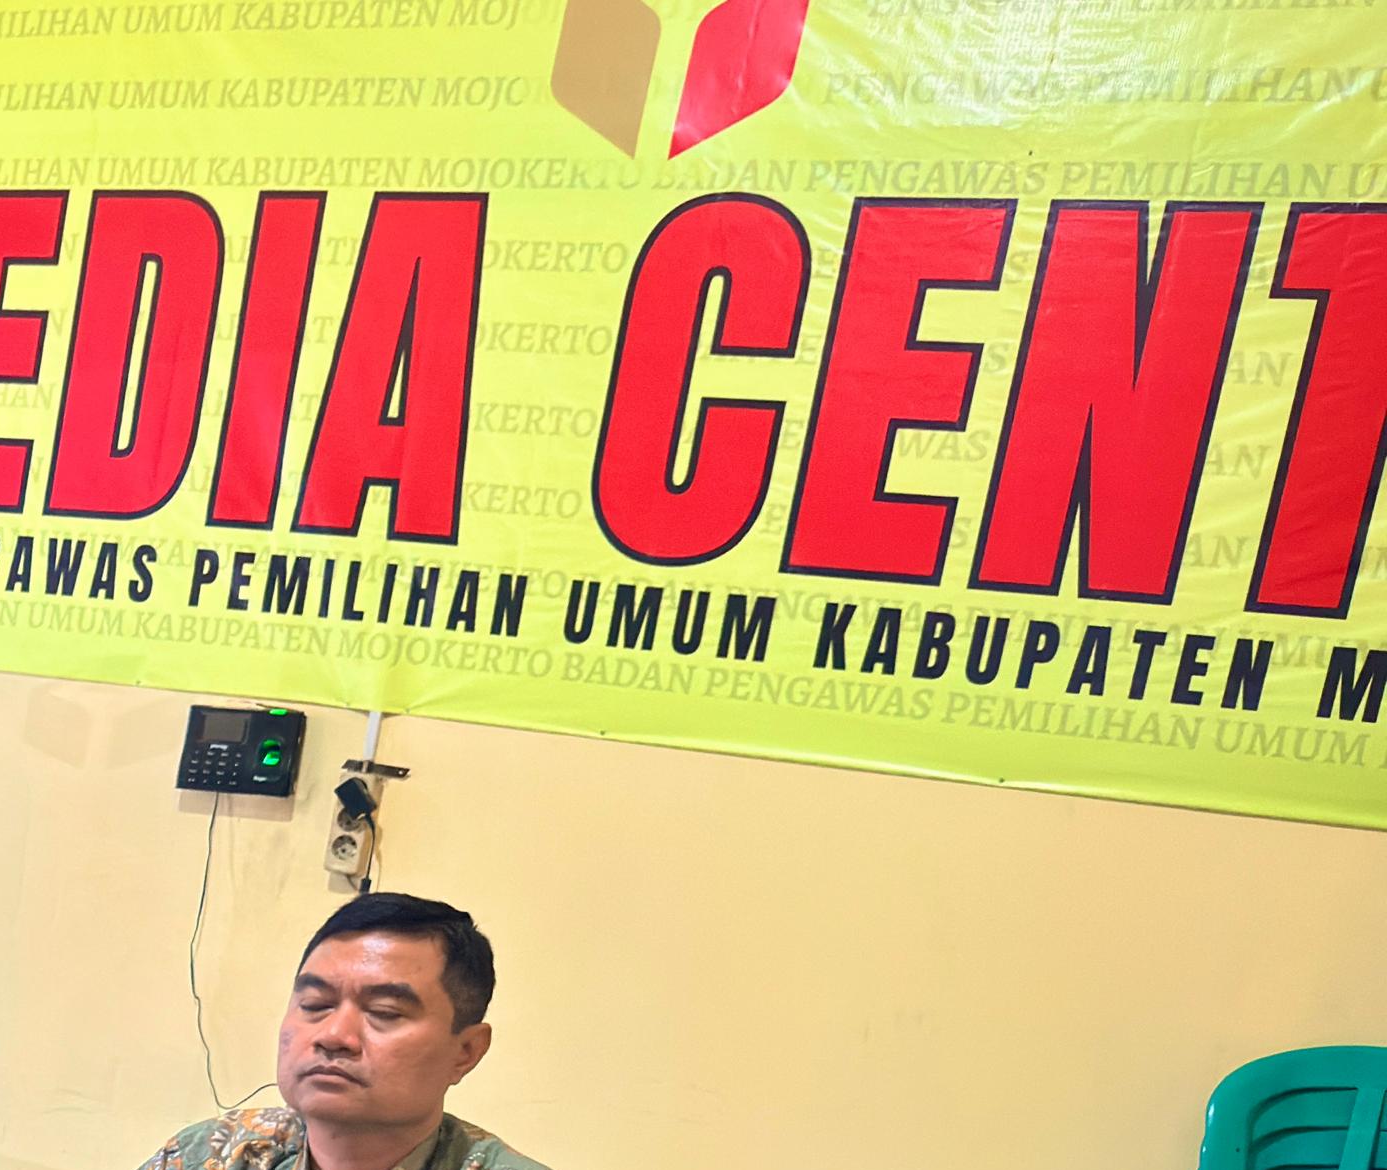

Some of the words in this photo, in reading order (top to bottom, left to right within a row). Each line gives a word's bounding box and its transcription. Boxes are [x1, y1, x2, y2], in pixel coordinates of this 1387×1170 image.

[122, 2, 222, 33] UMUM
[230, 0, 441, 32] KABUPATEN
[111, 79, 211, 110] UMUM
[220, 76, 426, 109] KABUPATEN
[98, 157, 197, 188] UMUM
[204, 154, 409, 188] KABUPATEN
[803, 158, 1049, 195] PENGAWAS
[1056, 162, 1339, 198] PEMILIHAN
[483, 239, 629, 274] OKERTO
[473, 402, 599, 439] KERTO
[591, 192, 1387, 620] CENT
[462, 481, 583, 520] KERTO
[188, 549, 529, 638] PEMILIHAN
[563, 579, 778, 663] UMUM
[812, 602, 1274, 712] KABUPATEN
[27, 599, 126, 638] UMUM
[130, 609, 334, 657] KABUPATEN
[337, 628, 555, 680] MOJOKERTO
[561, 649, 699, 697] BADAN
[702, 664, 937, 722] PENGAWAS
[941, 690, 1207, 752] PEMILIHAN
[1213, 717, 1373, 769] UMUM
